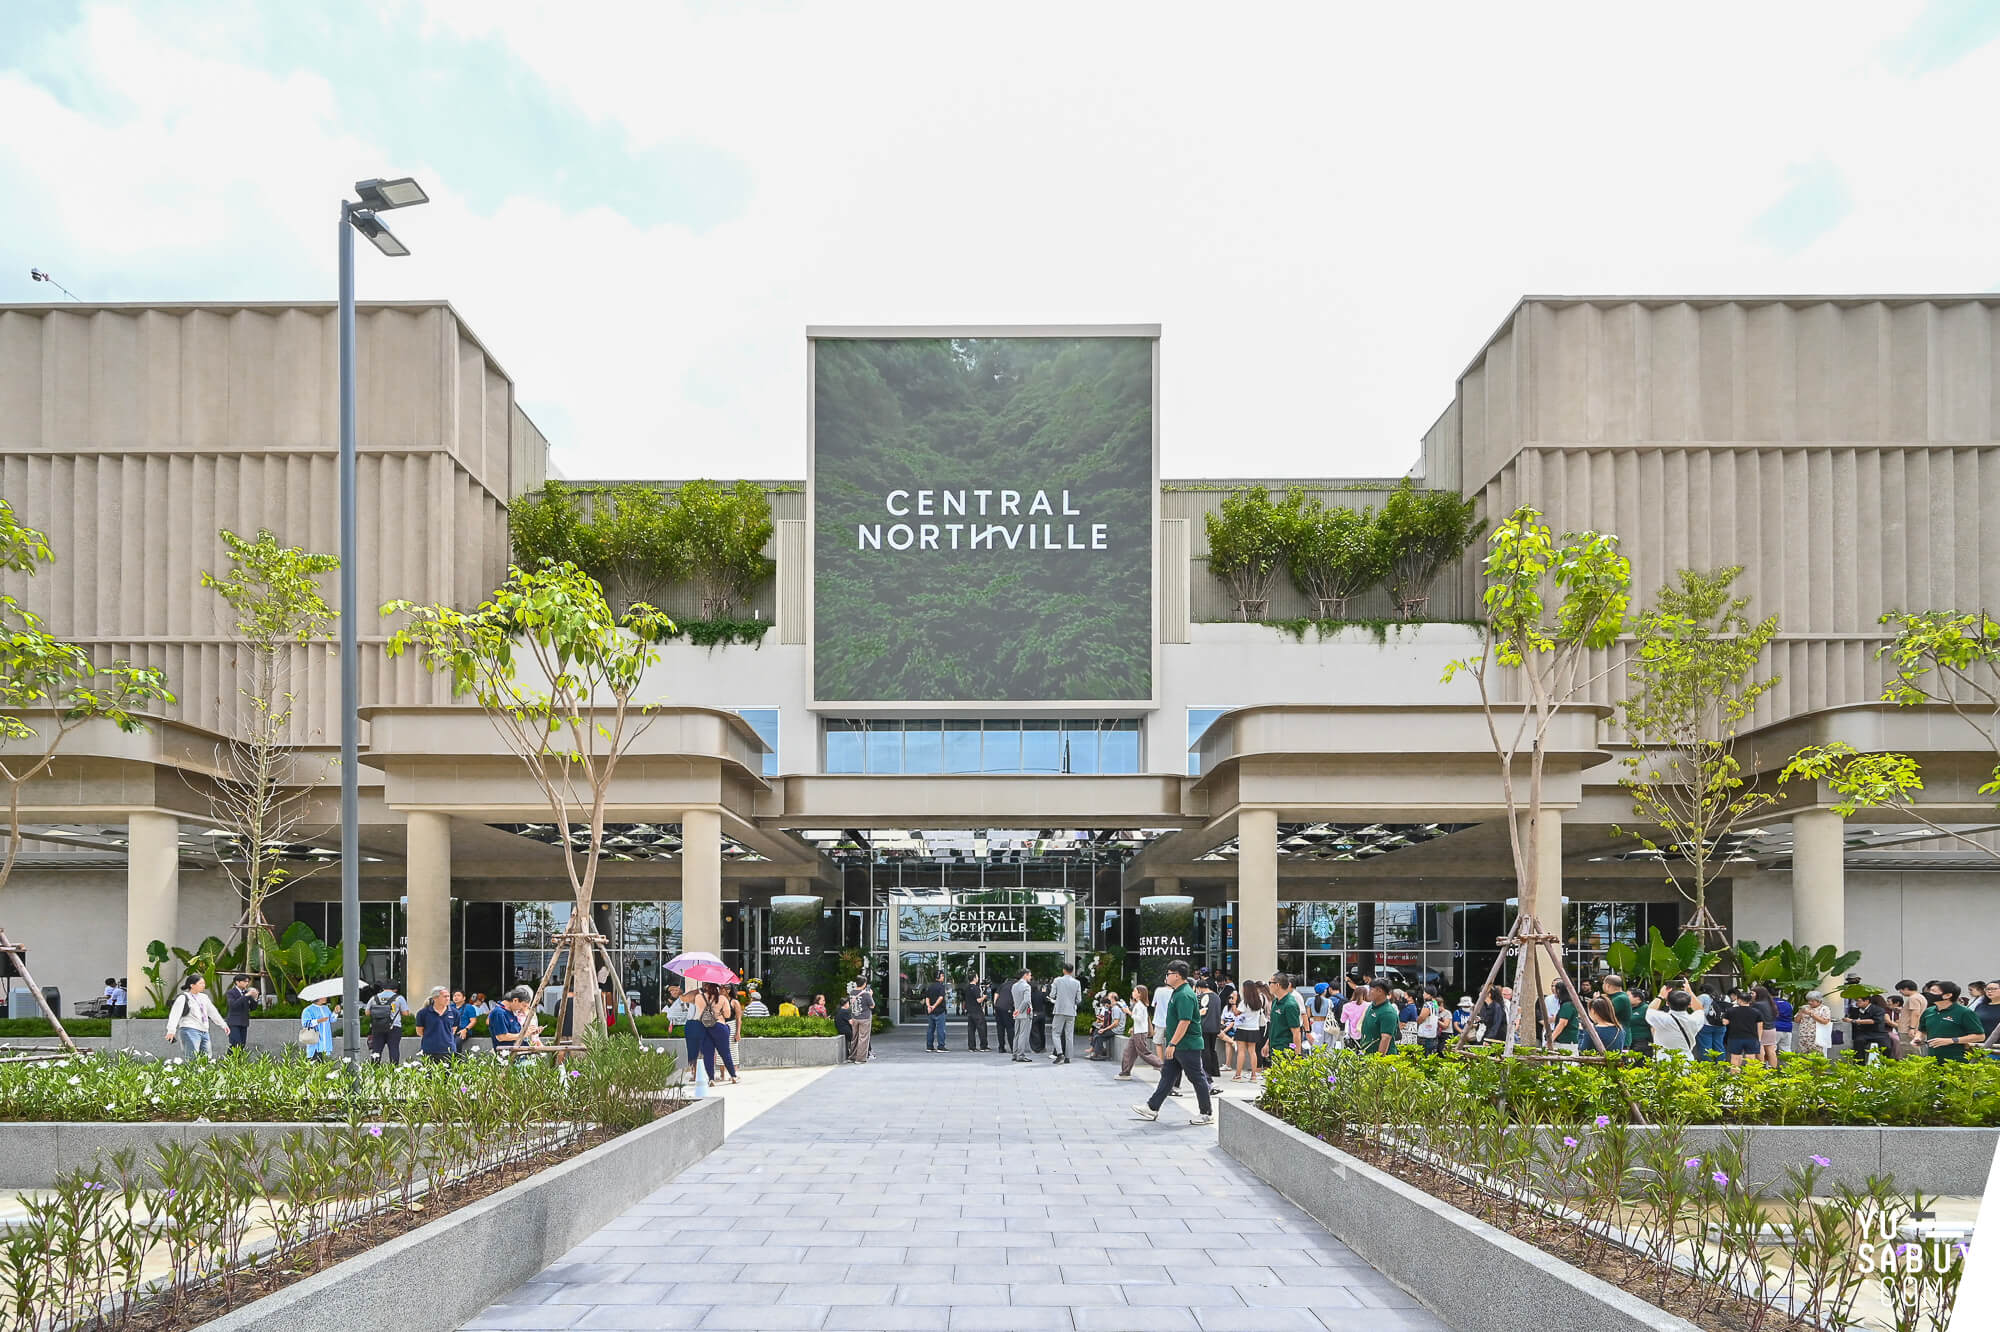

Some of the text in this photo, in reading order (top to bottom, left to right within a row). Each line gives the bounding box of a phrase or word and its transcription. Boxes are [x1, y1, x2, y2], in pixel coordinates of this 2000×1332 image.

[886, 489, 1081, 516] CENTRAL
[858, 523, 1108, 550] NORTHVILLE
[949, 911, 1016, 921] CENTRAL
[940, 922, 1027, 933] NORTHVILLE
